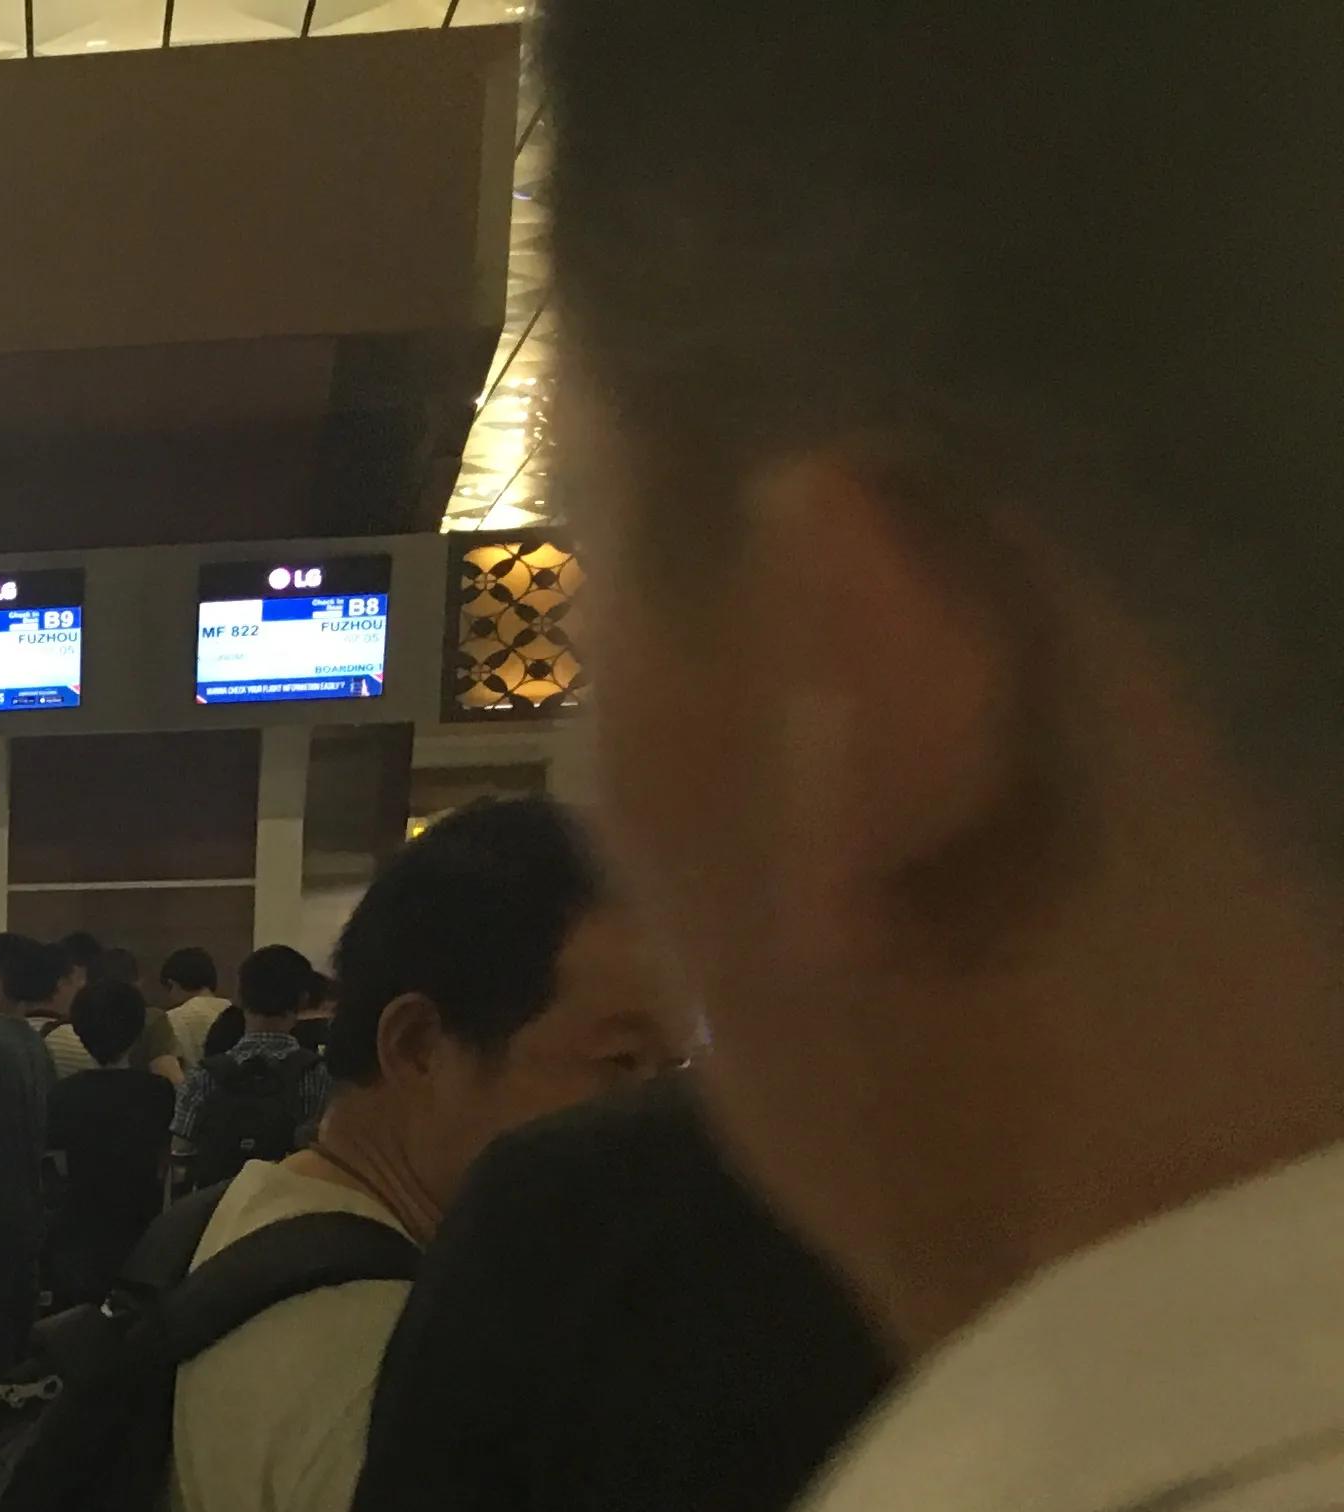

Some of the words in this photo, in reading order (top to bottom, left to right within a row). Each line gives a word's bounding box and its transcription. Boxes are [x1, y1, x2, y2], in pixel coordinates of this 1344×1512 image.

[294, 569, 321, 588] LG
[348, 598, 379, 616] B8
[44, 611, 74, 628] B9
[321, 620, 382, 632] FUZHOU
[18, 632, 77, 644] FUZHOU
[202, 626, 225, 638] MF
[231, 624, 259, 637] 822
